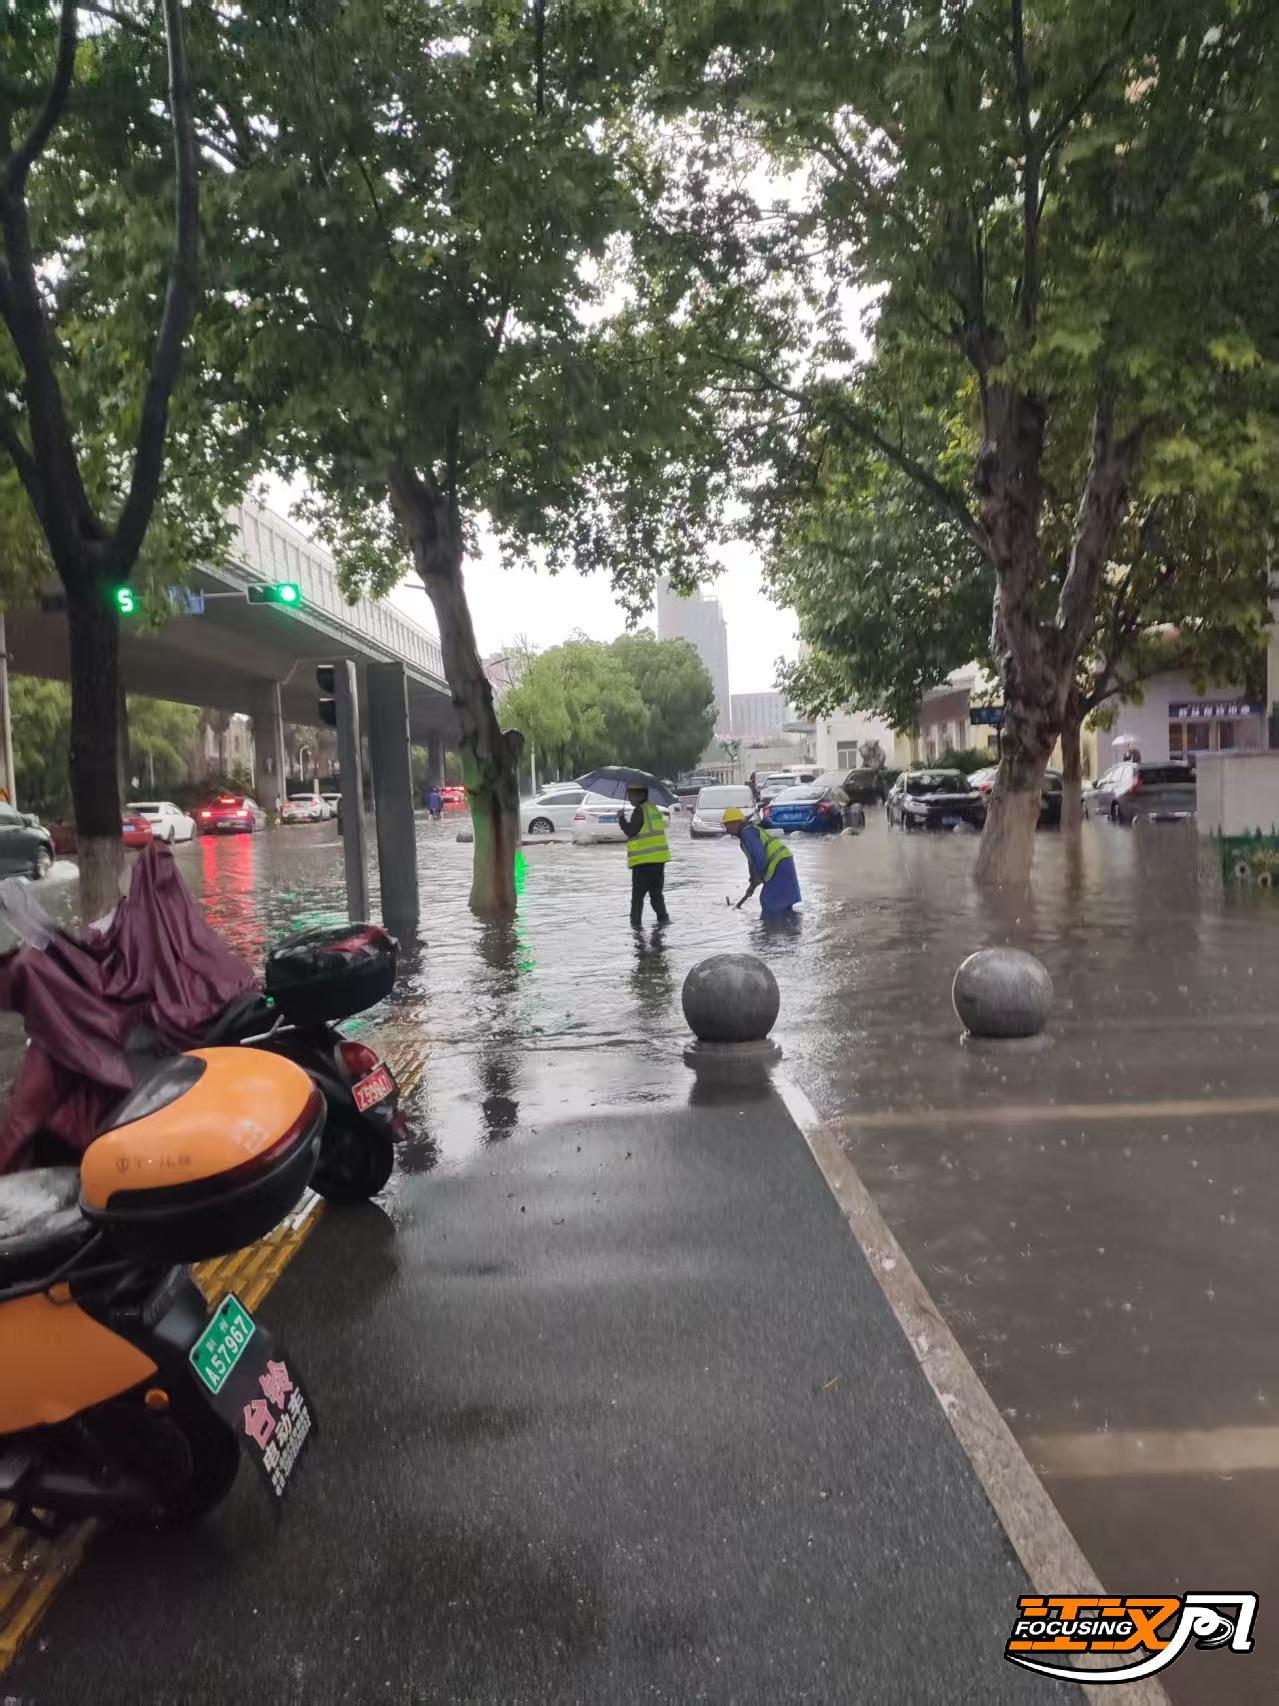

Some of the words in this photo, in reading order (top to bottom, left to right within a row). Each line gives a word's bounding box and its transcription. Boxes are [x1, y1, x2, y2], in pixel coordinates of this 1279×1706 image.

[205, 1315, 248, 1386] A57967
[263, 1386, 304, 1473] 电动车
